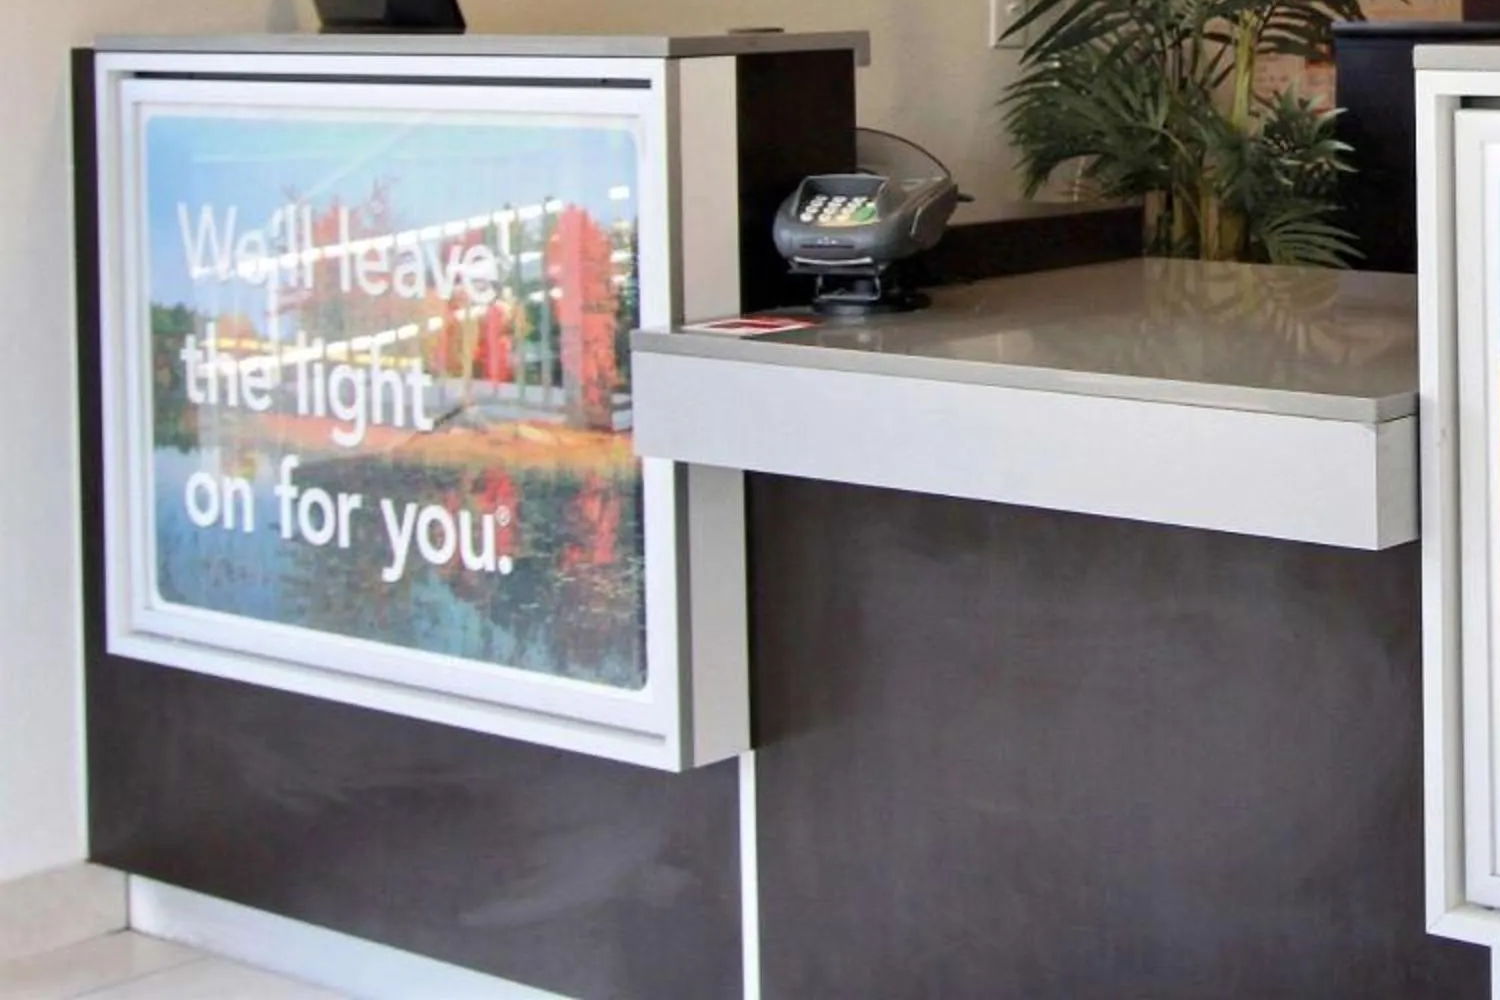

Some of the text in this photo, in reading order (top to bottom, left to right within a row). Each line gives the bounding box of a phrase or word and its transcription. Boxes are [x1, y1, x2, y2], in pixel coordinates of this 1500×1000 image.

[176, 201, 499, 304] We'll leave
[180, 320, 434, 447] the light
[185, 469, 254, 533] on
[274, 455, 362, 549] for
